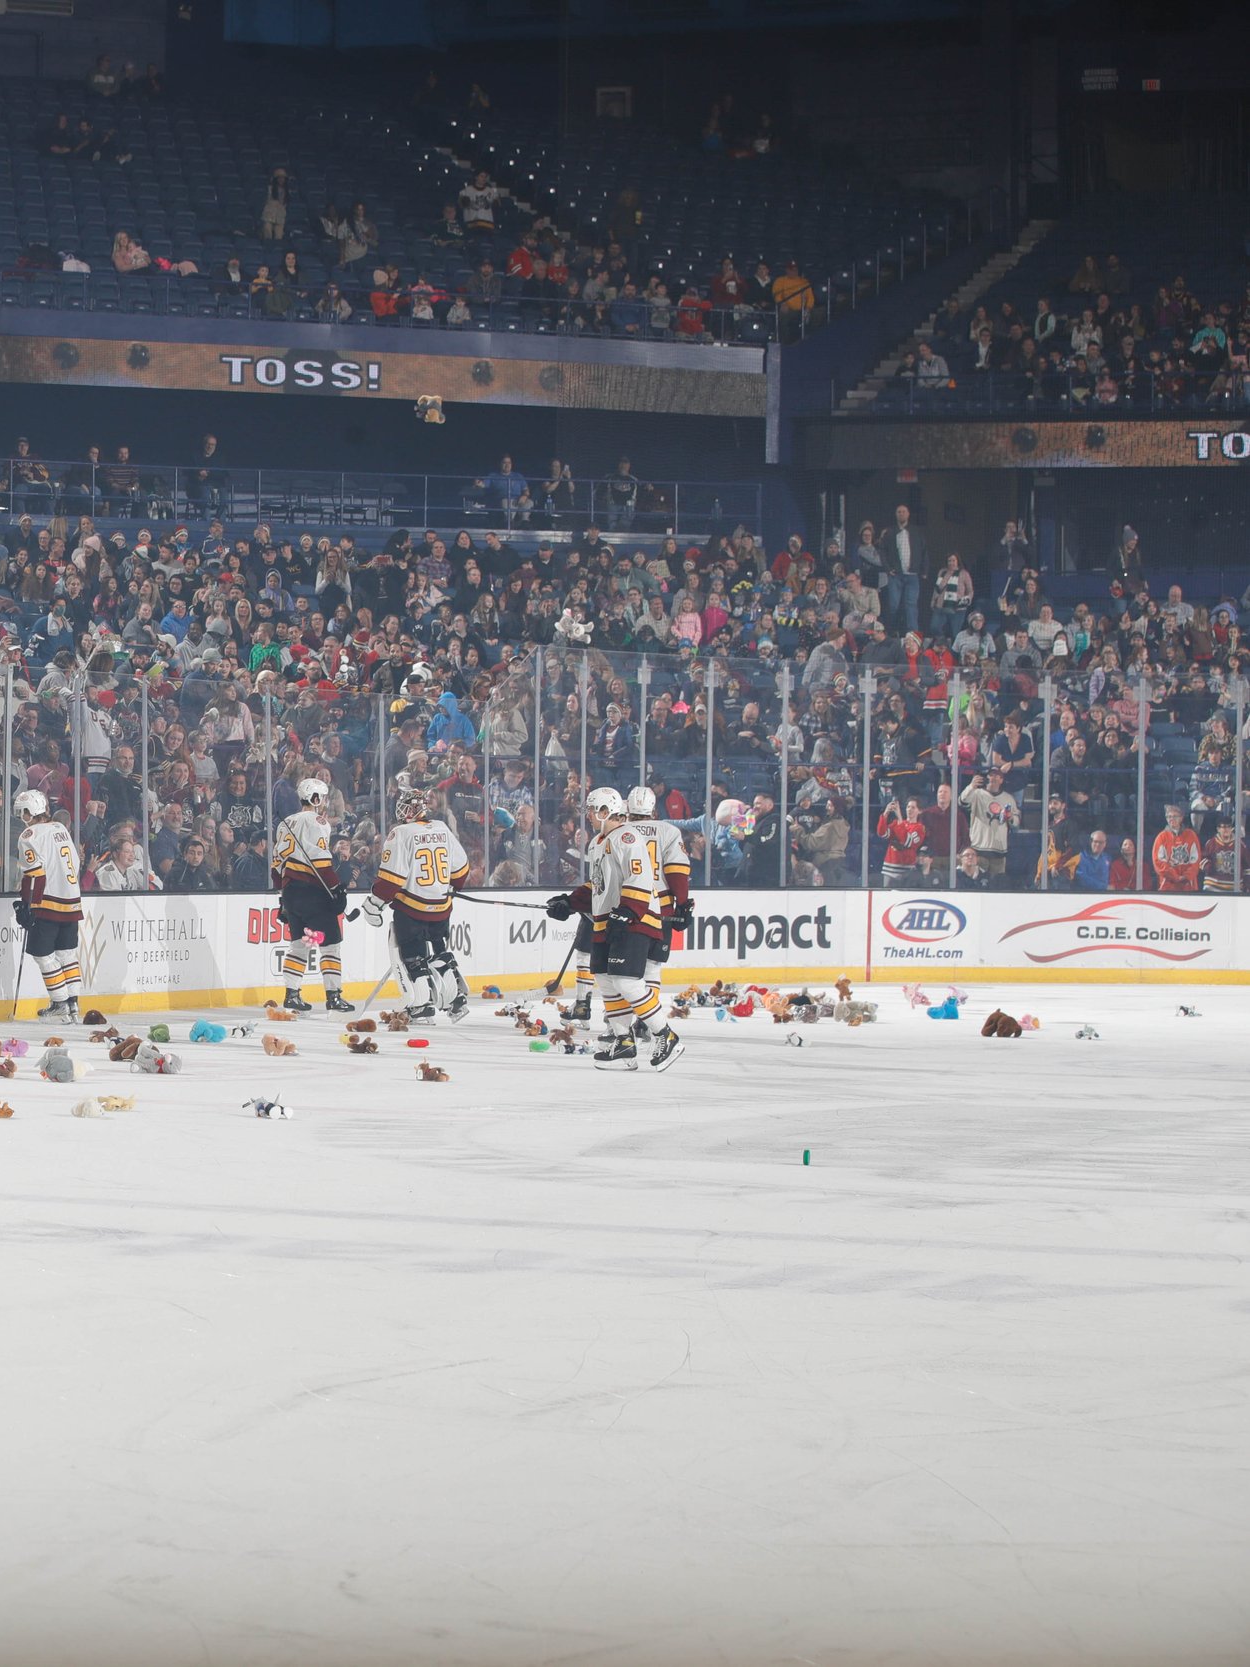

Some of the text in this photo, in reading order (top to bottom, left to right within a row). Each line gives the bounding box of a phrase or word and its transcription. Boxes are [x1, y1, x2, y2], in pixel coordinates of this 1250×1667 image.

[221, 356, 380, 389] TOSS!
[633, 824, 657, 837] SSON
[24, 848, 36, 864] 3
[381, 849, 392, 863] 6
[61, 845, 78, 885] 3
[415, 846, 450, 887] 36
[631, 859, 643, 875] 5
[896, 908, 951, 931] AHL
[110, 917, 207, 942] WHITEHALL
[686, 904, 832, 960] impact
[1076, 926, 1211, 942] C.D.E. Collision
[127, 949, 190, 964] OF DEERFIELD
[275, 949, 316, 973] TE
[883, 946, 963, 960] TheAHL.com
[136, 974, 181, 985] HEALTHCARE
